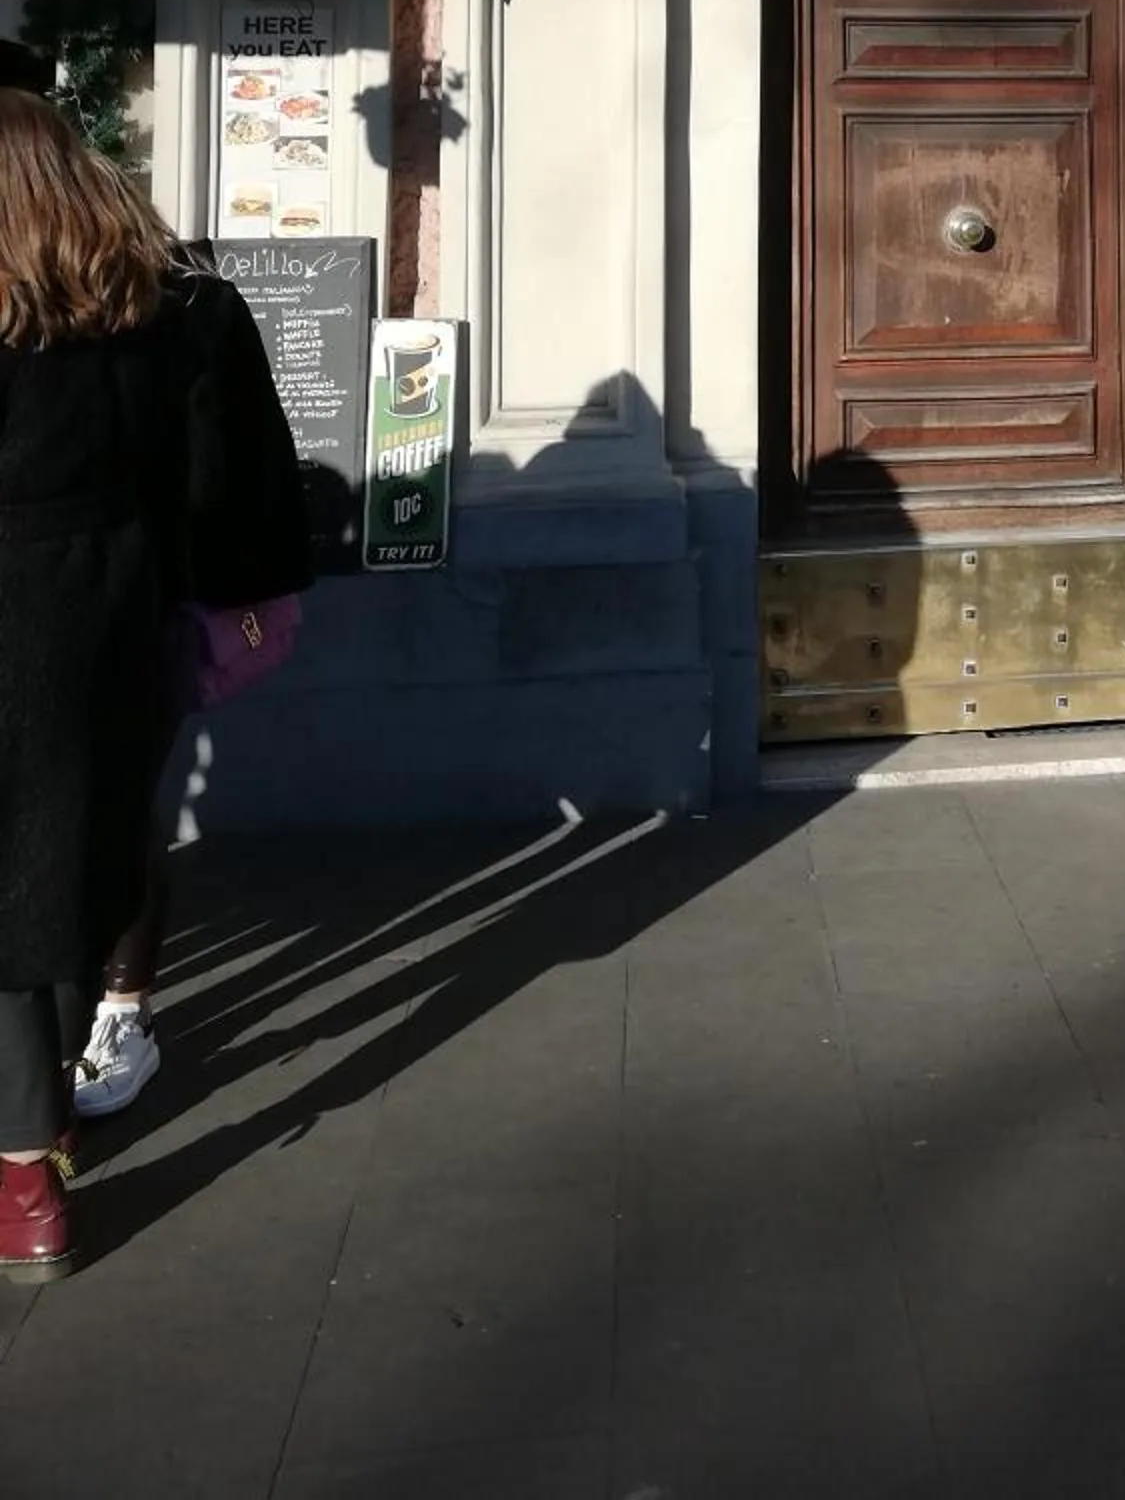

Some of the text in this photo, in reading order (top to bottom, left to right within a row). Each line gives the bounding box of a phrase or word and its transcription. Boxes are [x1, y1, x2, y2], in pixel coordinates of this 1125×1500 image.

[243, 16, 313, 34] HERE
[279, 38, 327, 56] EAT
[378, 436, 444, 481] COFFEE
[377, 548, 409, 560] TRY
